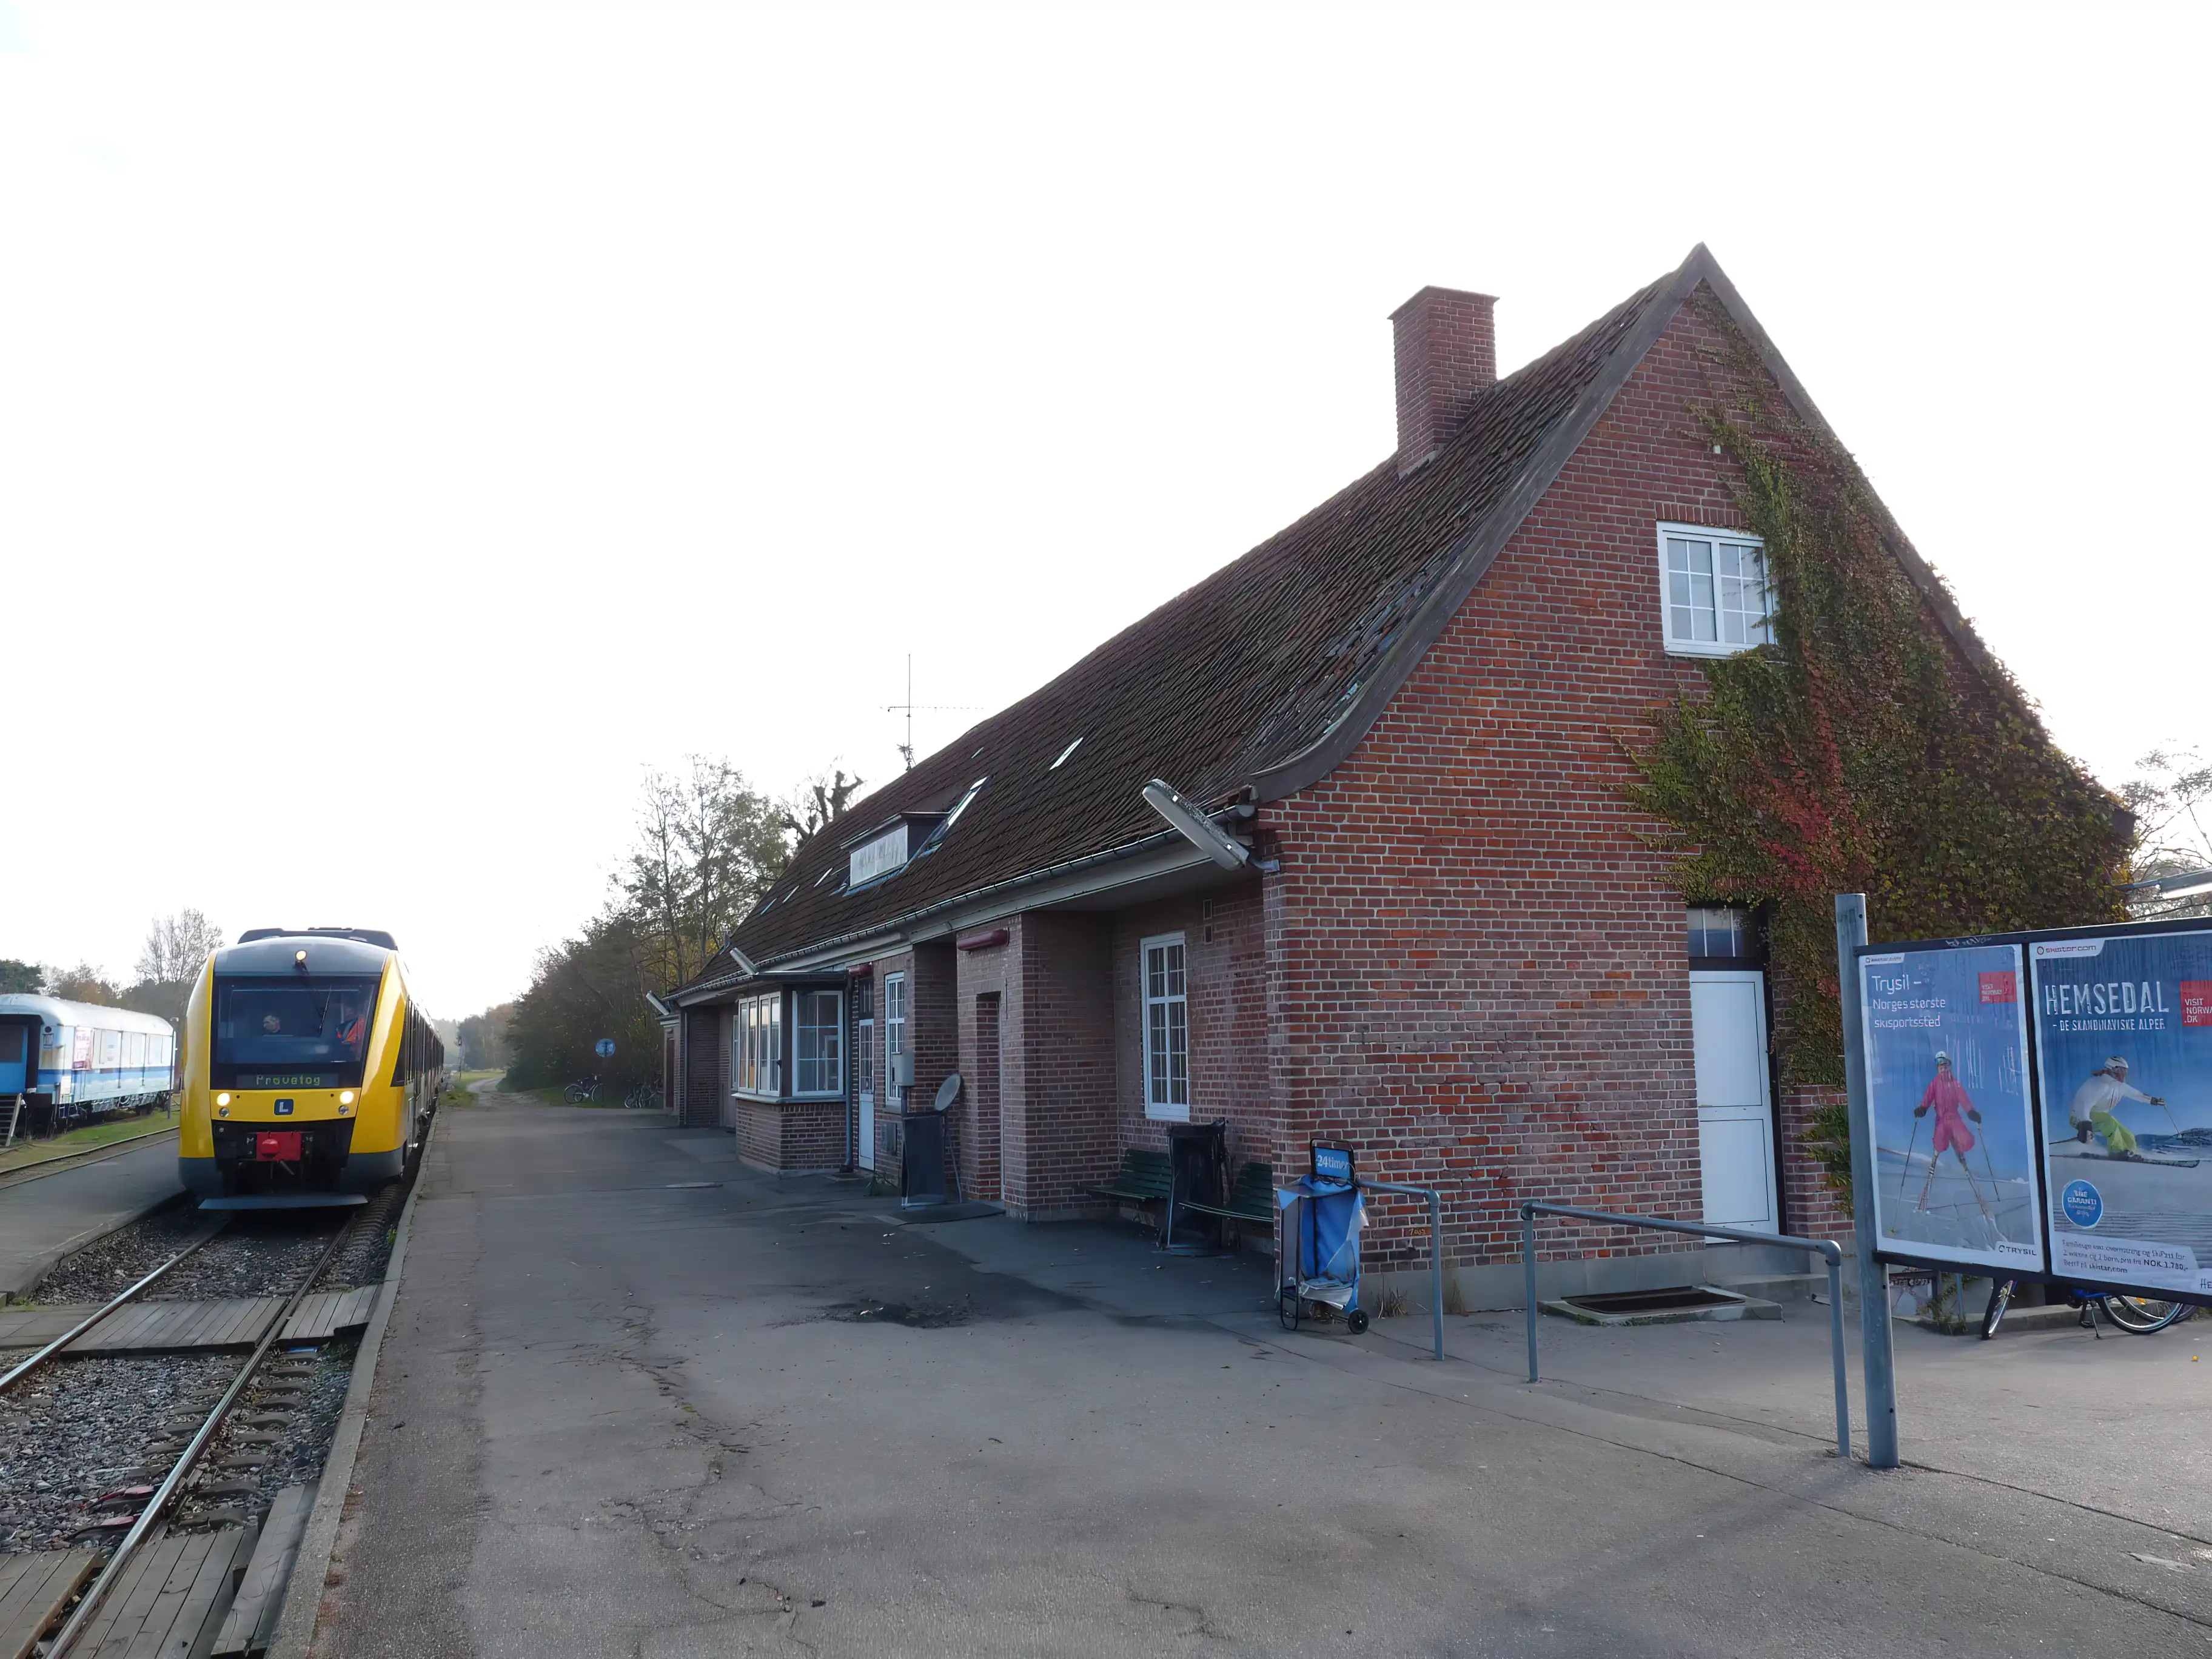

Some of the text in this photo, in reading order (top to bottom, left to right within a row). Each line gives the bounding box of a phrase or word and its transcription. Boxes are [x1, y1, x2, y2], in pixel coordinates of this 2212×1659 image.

[1871, 974, 1909, 994] Trysil
[2045, 981, 2169, 1014] HEMSEDAL
[1873, 999, 1908, 1011] Norges
[1874, 1013, 1940, 1030] skisportssted
[2060, 1020, 2070, 1031] DE
[2072, 1019, 2136, 1031] SKANDINAVISKE
[279, 1102, 289, 1112] L
[2006, 1246, 2037, 1256] TRYSIL
[2144, 1259, 2162, 1267] NOK
